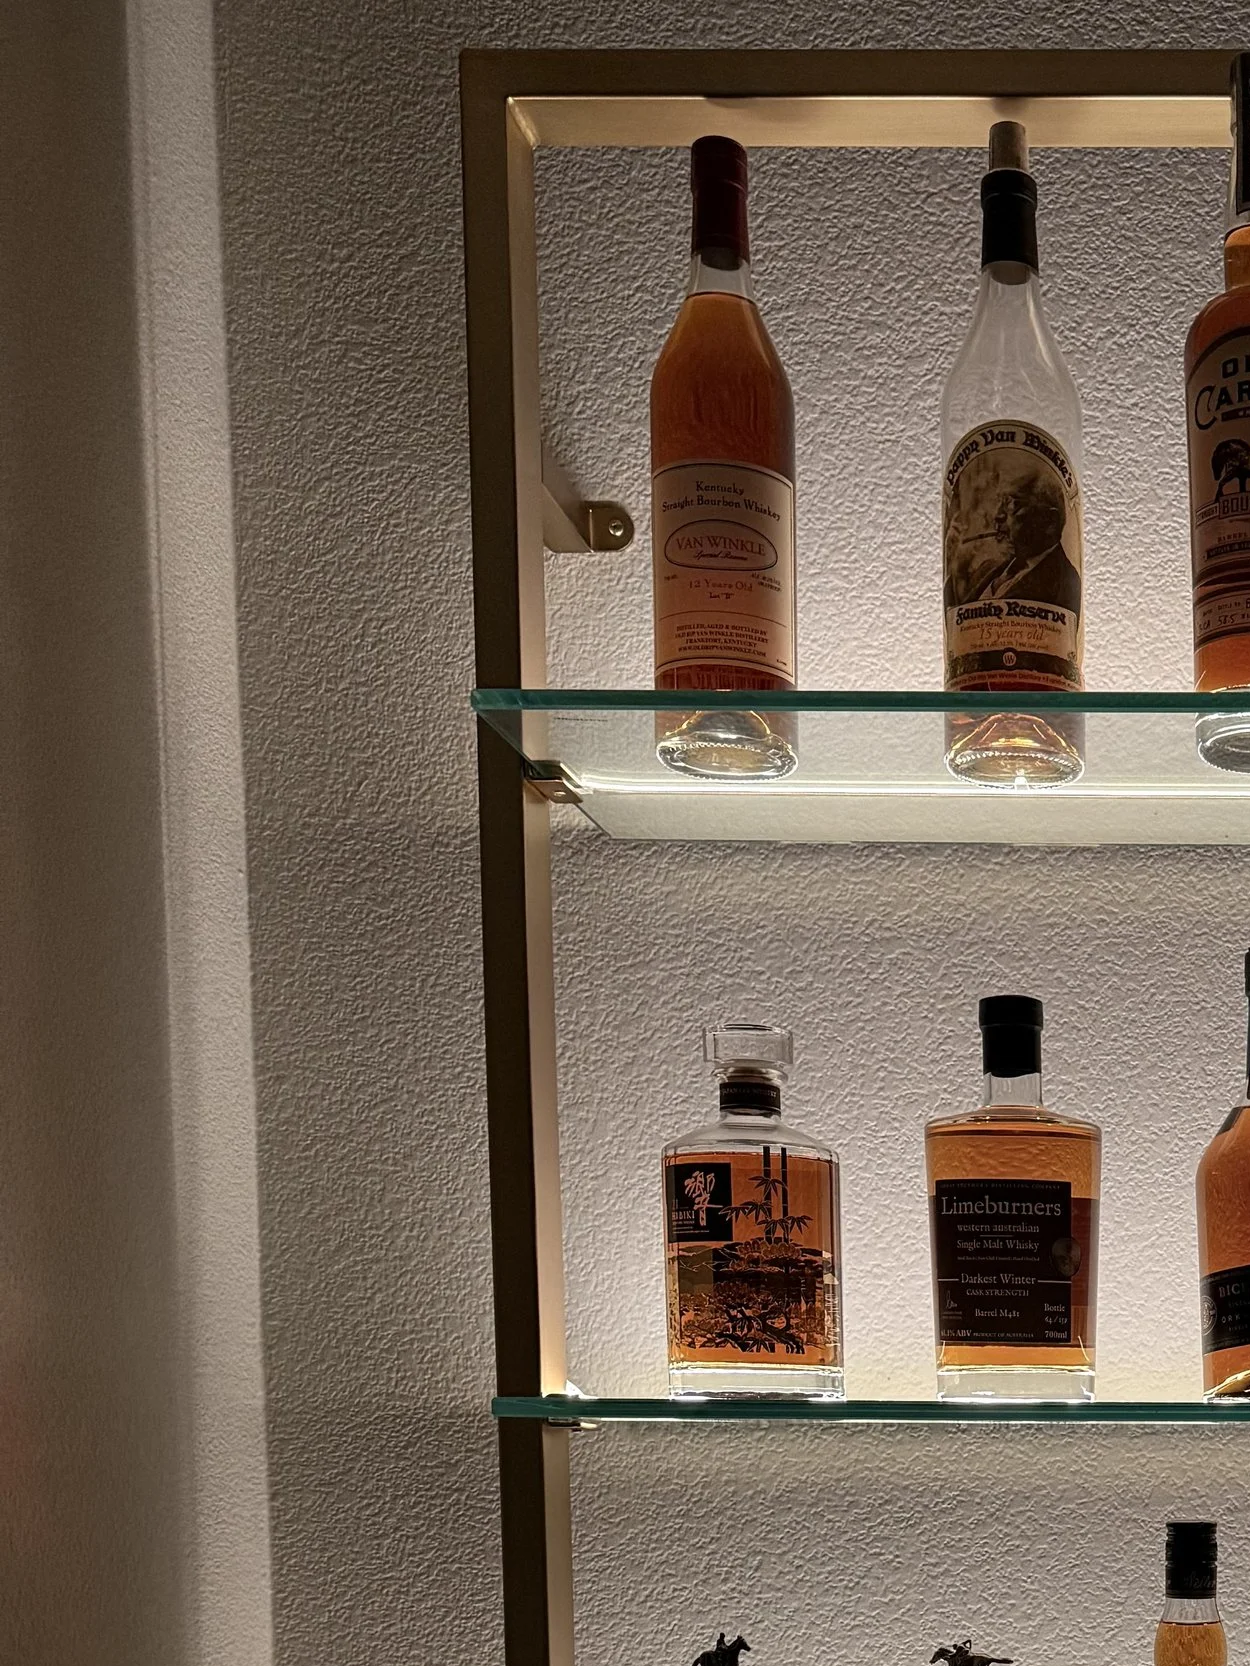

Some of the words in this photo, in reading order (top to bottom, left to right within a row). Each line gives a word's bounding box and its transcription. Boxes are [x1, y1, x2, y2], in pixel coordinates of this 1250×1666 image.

[946, 440, 980, 486] Pappy
[980, 430, 1016, 446] Van
[696, 481, 745, 496] Kentucky
[662, 496, 694, 512] Straight
[697, 495, 741, 508] Bourbon
[744, 499, 780, 521] Whiskey
[676, 536, 703, 550] VAN
[706, 536, 766, 557] WINKLE
[704, 579, 733, 589] Years
[735, 581, 753, 592] Old
[956, 602, 1004, 626] Family
[1004, 601, 1067, 626] Reserve
[980, 628, 992, 640] 15
[996, 629, 1023, 642] years
[1026, 628, 1044, 641] old
[941, 1195, 1062, 1216] Limeburners
[957, 1224, 991, 1232] western
[992, 1222, 1040, 1233] australian
[956, 1240, 981, 1252] Single
[983, 1240, 1003, 1249] Malt
[1005, 1240, 1040, 1253] Whisky
[961, 1273, 997, 1284] Darkest
[1000, 1274, 1037, 1285] Winter
[966, 1288, 985, 1296] CASK
[985, 1288, 1030, 1297] STRENGTH
[975, 1308, 998, 1317] Barrel
[1044, 1303, 1066, 1312] Bottle
[956, 1329, 973, 1337] ABV
[1044, 1330, 1068, 1339] 700ml
